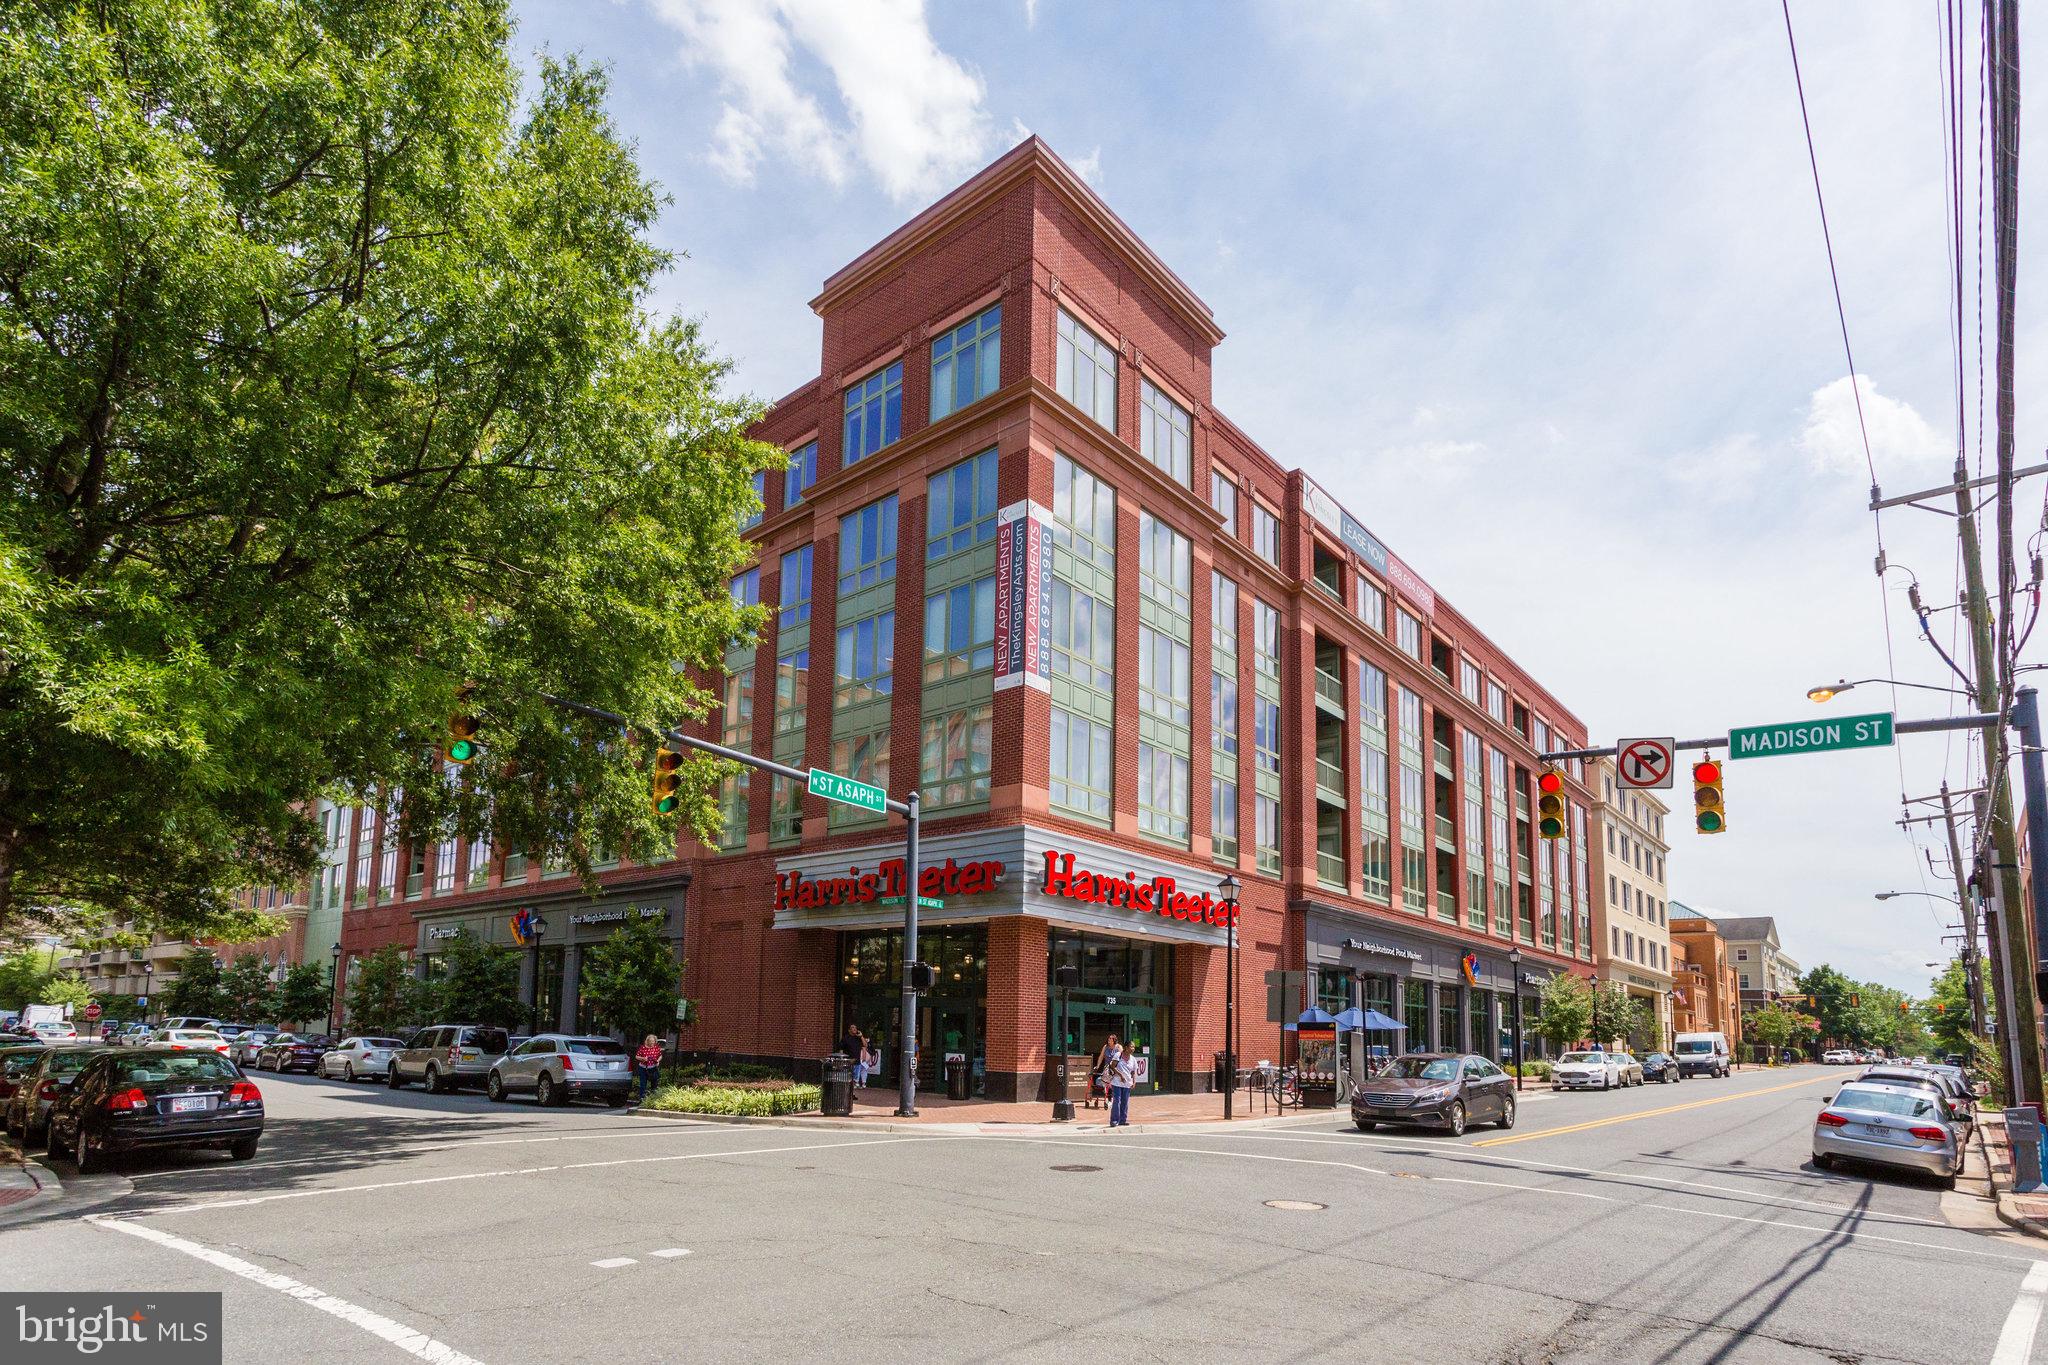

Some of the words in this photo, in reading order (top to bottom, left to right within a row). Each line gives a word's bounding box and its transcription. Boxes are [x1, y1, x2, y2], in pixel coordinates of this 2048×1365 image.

[1343, 520, 1367, 551] LEASE
[1367, 541, 1386, 566] NOW
[998, 528, 1011, 629] APARTMENTS
[1011, 523, 1024, 668] TheKingsleyApts.com
[1028, 525, 1040, 628] APARTMENTS
[1040, 532, 1052, 674] 888.694.0980
[997, 635, 1008, 672] NEW
[1027, 629, 1038, 669] NEW
[1741, 725, 1841, 753] MADISON
[1854, 720, 1884, 742] ST
[812, 776, 818, 786] N
[819, 776, 834, 793] ST
[836, 782, 874, 805] ASAPH
[875, 795, 882, 803] ST
[774, 866, 880, 910] Harris
[879, 857, 1005, 898] Teter
[1042, 850, 1154, 912] Harris
[569, 915, 582, 924] Your
[583, 911, 623, 924] Neighborhood
[640, 907, 664, 917] Marke
[1350, 938, 1362, 949] Your
[1362, 941, 1395, 956] Neighborhood
[1107, 996, 1117, 1005] 735
